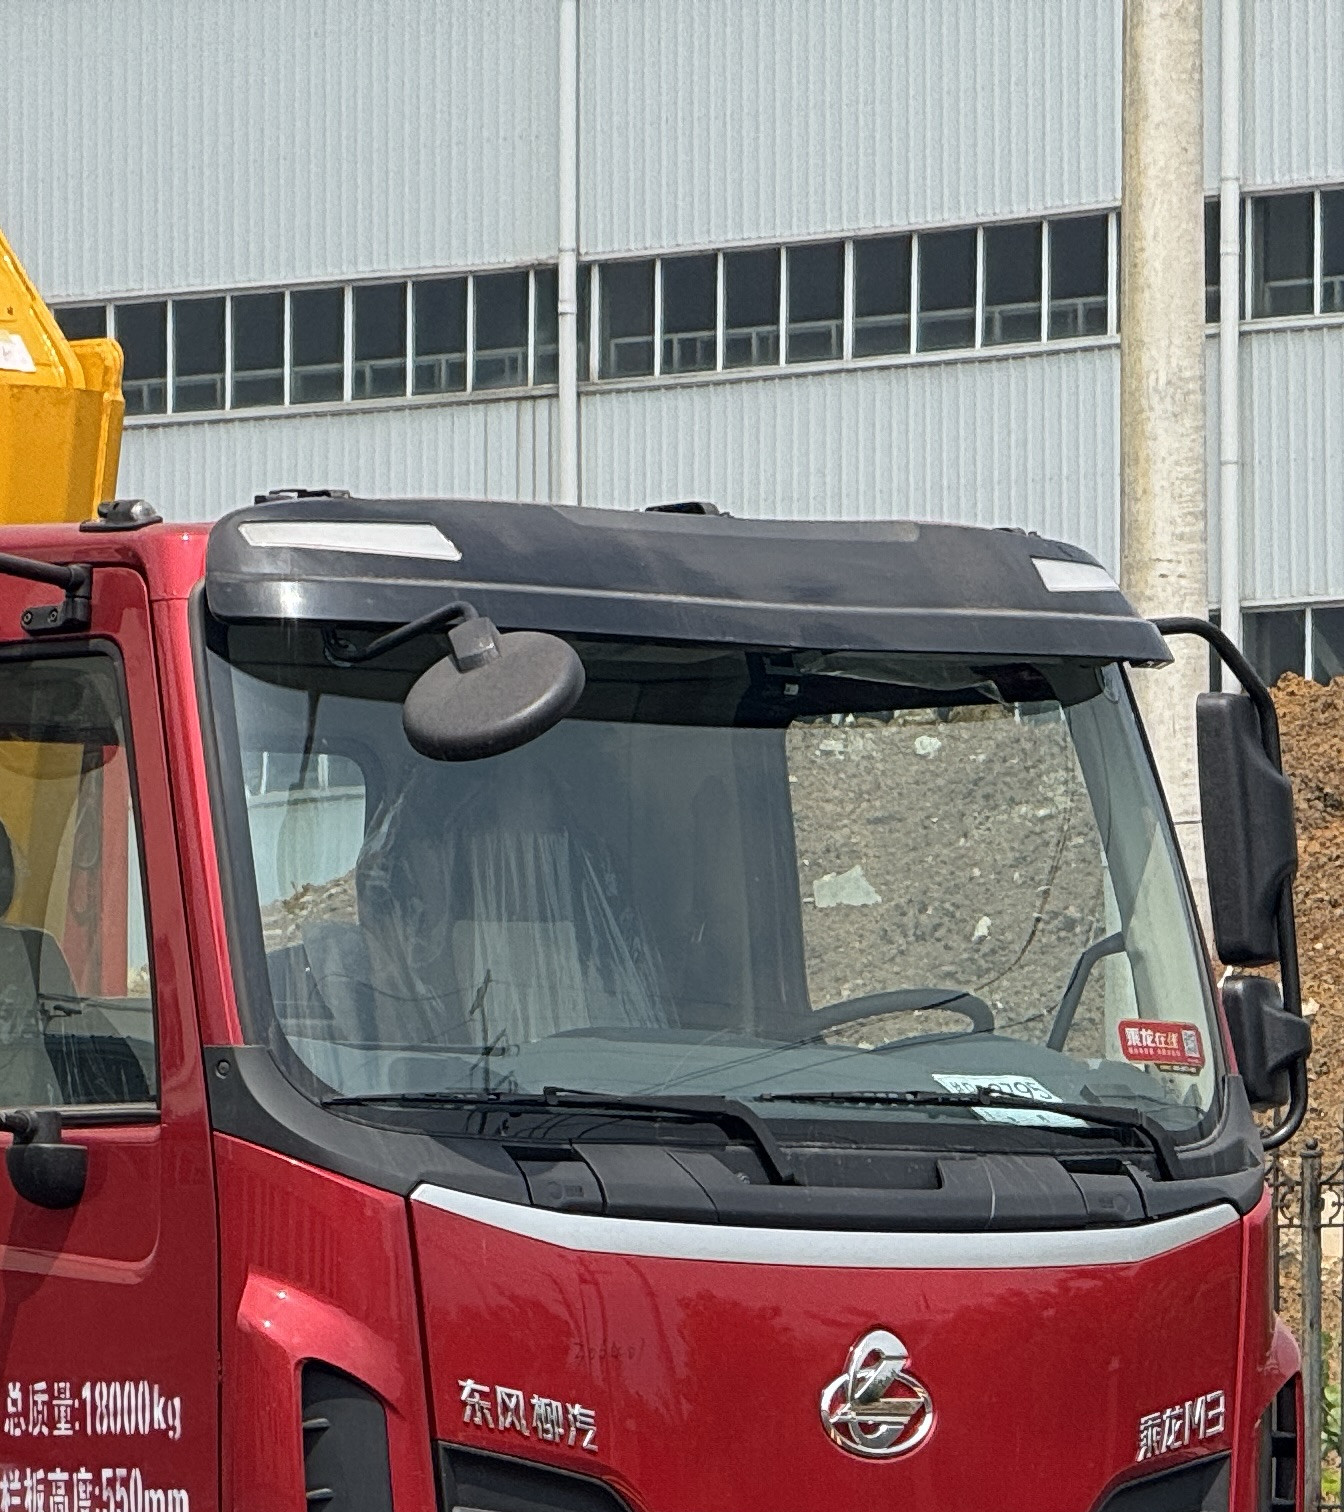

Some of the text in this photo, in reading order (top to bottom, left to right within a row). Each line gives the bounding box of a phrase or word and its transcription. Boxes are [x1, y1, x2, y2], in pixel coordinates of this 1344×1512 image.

[3, 1379, 182, 1441] 总质量:18000kg
[457, 1378, 599, 1452] 东风柳汽
